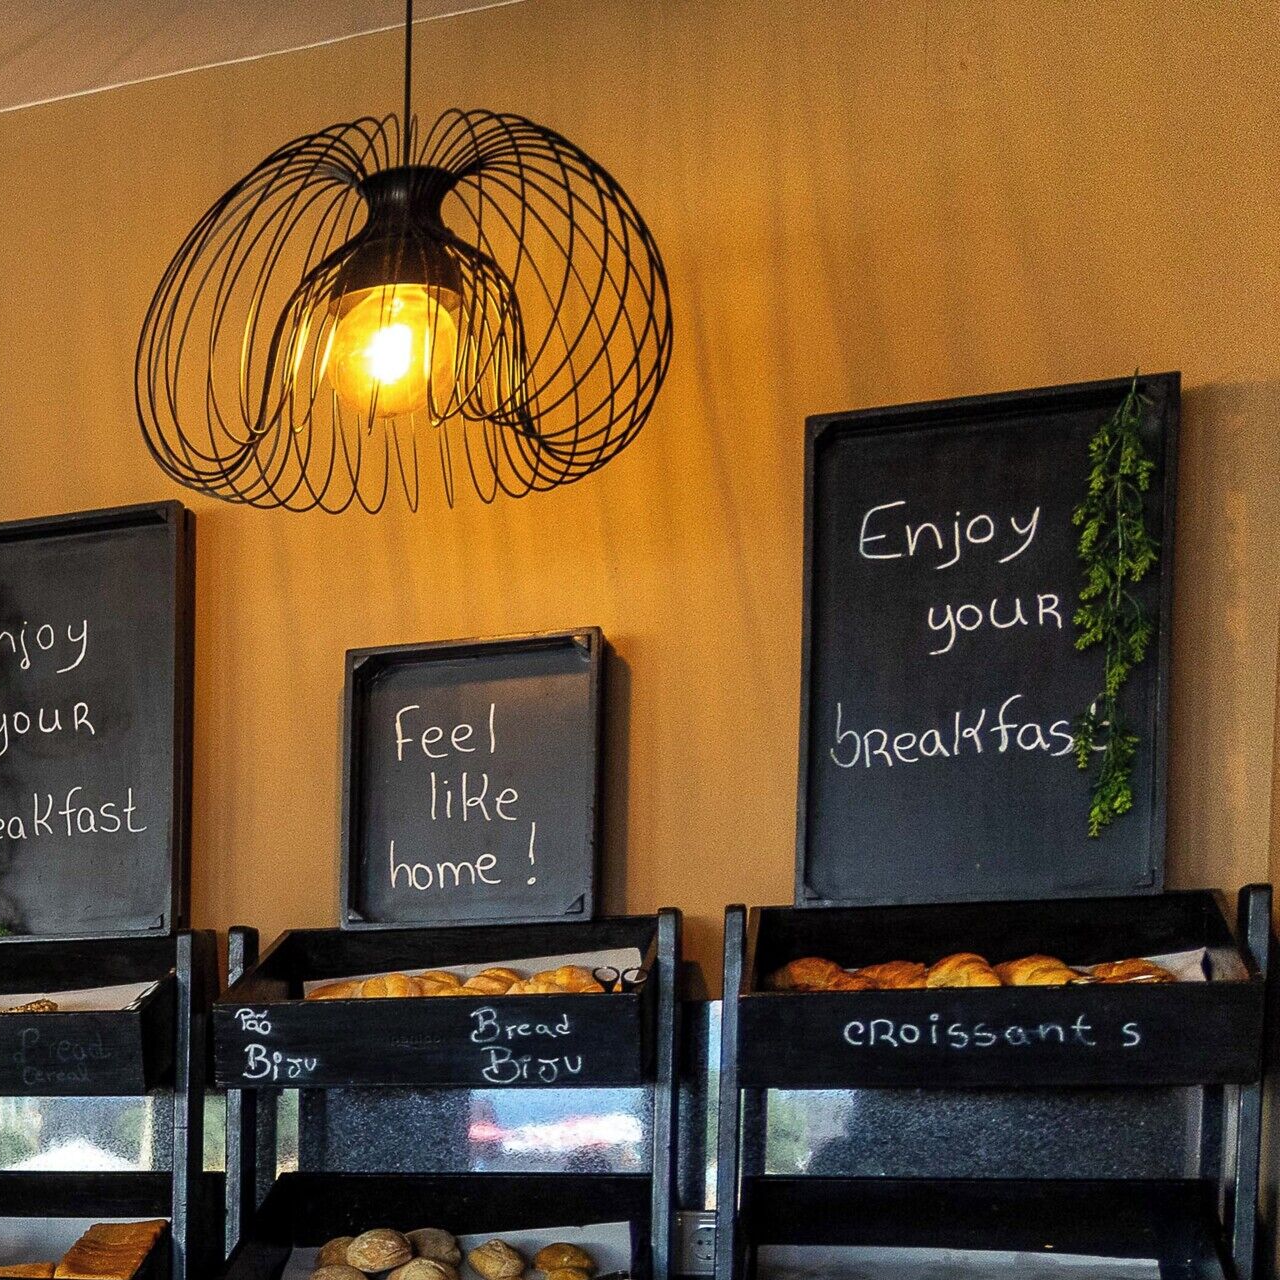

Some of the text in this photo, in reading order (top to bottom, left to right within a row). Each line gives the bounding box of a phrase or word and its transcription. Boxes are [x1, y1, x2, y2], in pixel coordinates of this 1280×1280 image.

[858, 500, 1040, 570] Enjoy
[394, 702, 496, 761] Feel
[234, 1007, 272, 1035] Pão
[470, 1005, 571, 1043] Bread
